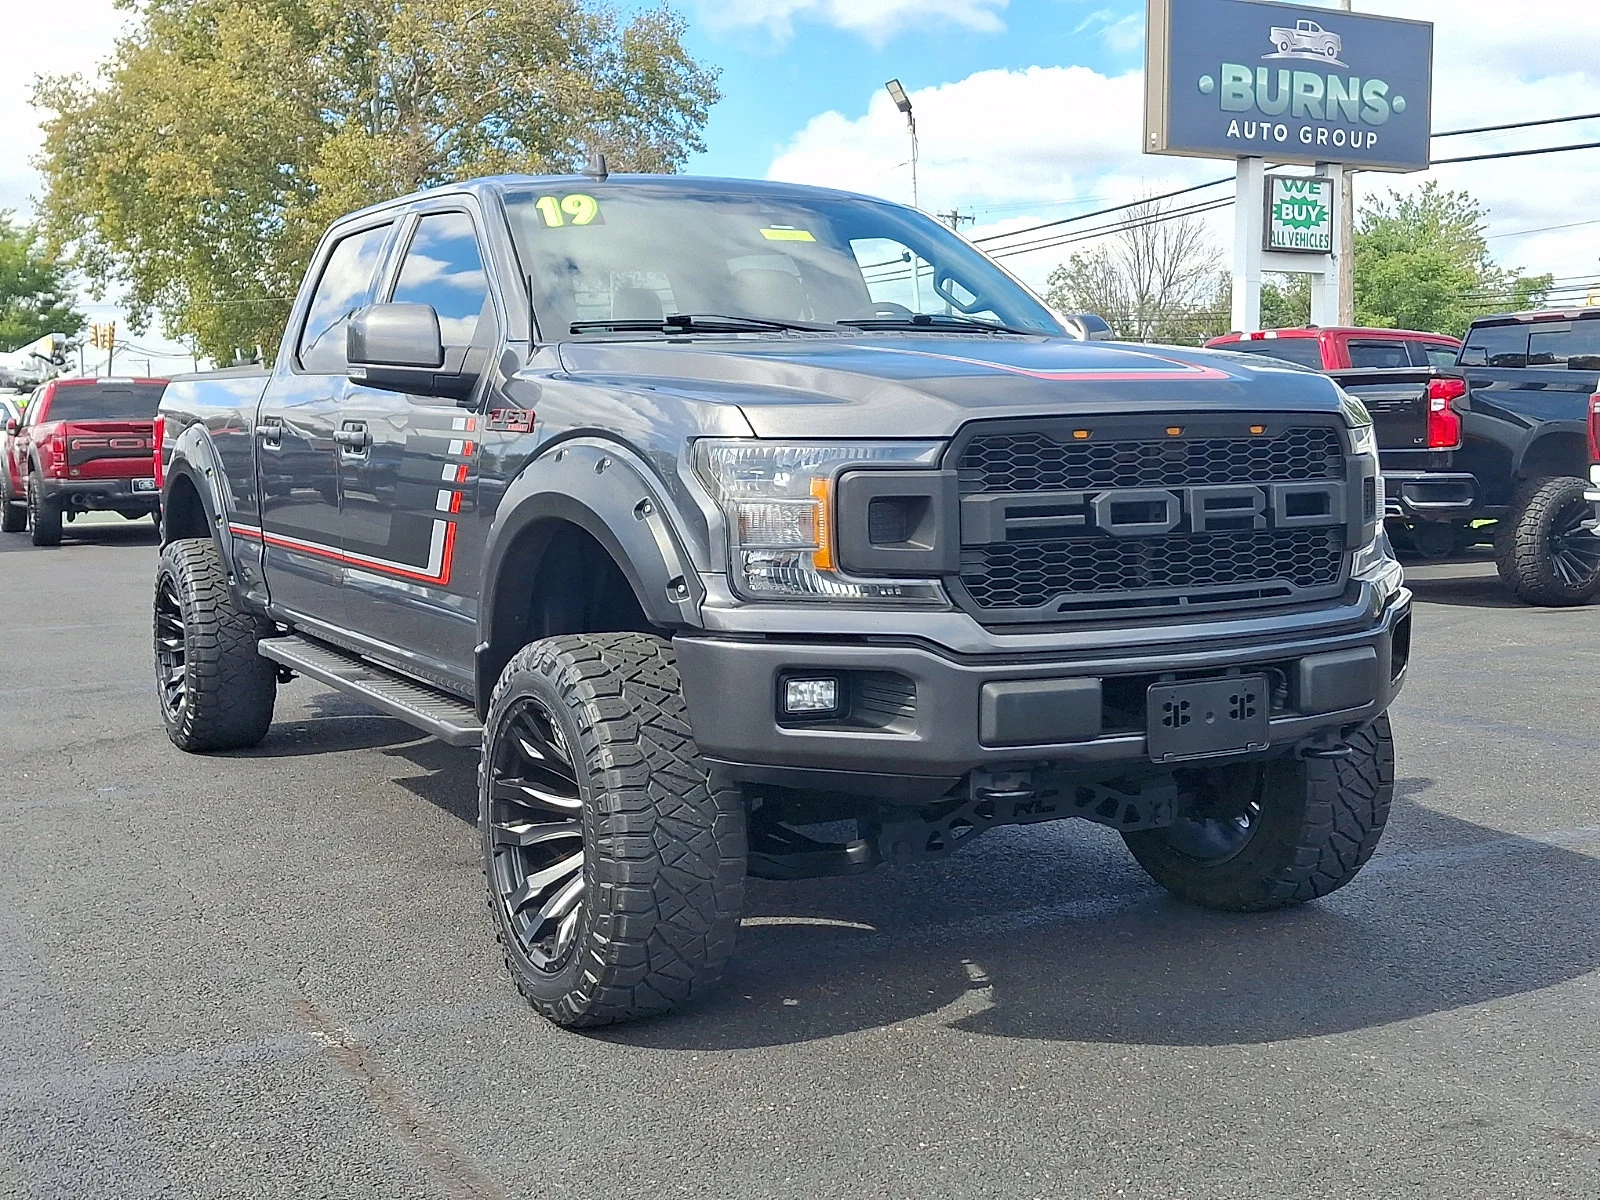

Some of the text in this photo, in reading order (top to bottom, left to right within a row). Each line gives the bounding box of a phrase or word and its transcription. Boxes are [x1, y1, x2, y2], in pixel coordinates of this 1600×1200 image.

[1220, 63, 1390, 125] BURNS
[1226, 119, 1378, 149] AUTO GROUP
[1281, 179, 1321, 195] WE
[535, 194, 598, 228] 19
[1281, 203, 1320, 221] BUY
[1271, 230, 1329, 249] ALL VEHICLES
[961, 481, 1347, 545] FORD
